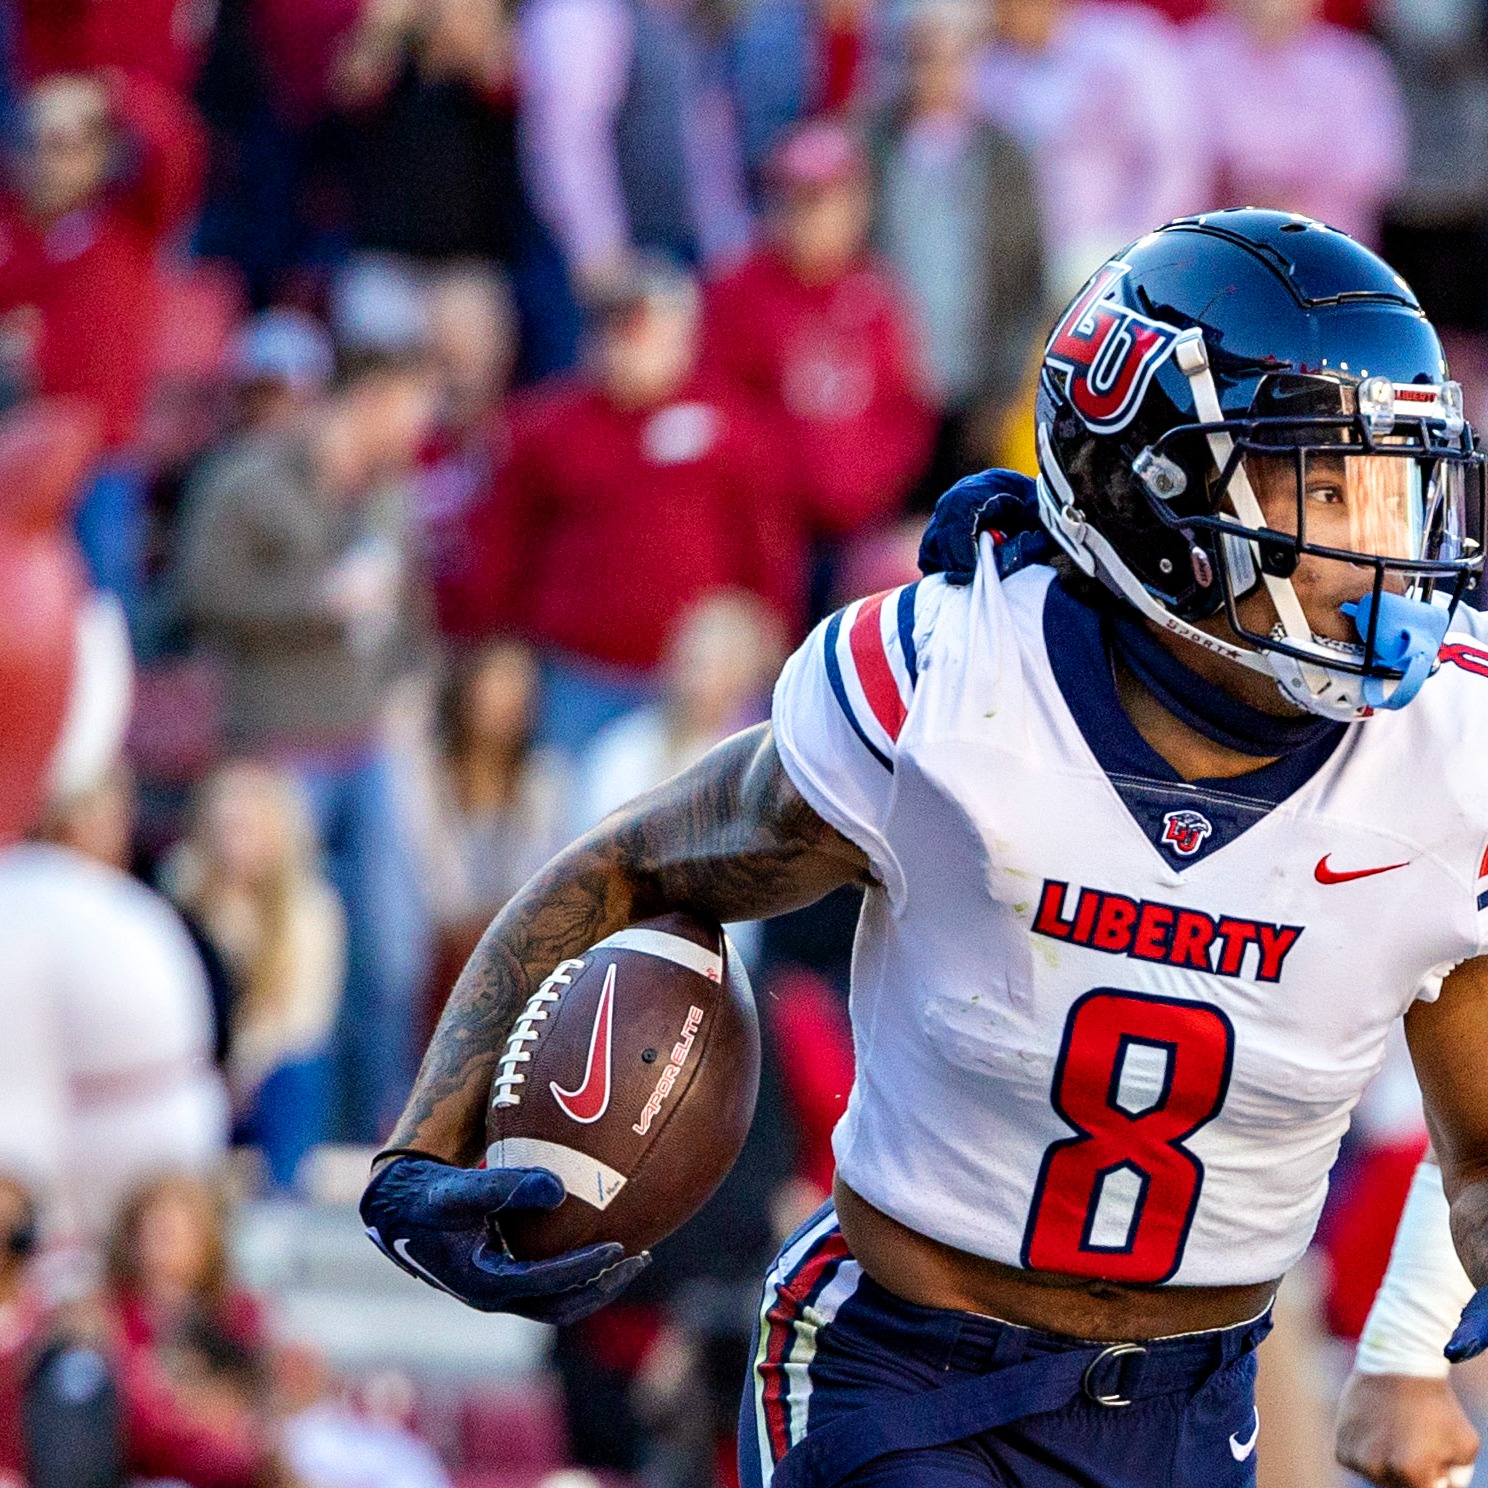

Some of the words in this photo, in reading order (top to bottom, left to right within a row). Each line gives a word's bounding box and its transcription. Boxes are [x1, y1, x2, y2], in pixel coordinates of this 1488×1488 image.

[1031, 878, 1306, 983] LIBERTY
[632, 1064, 681, 1135] VAPOR
[671, 1005, 704, 1067] ELITE
[1020, 986, 1235, 1284] 8
